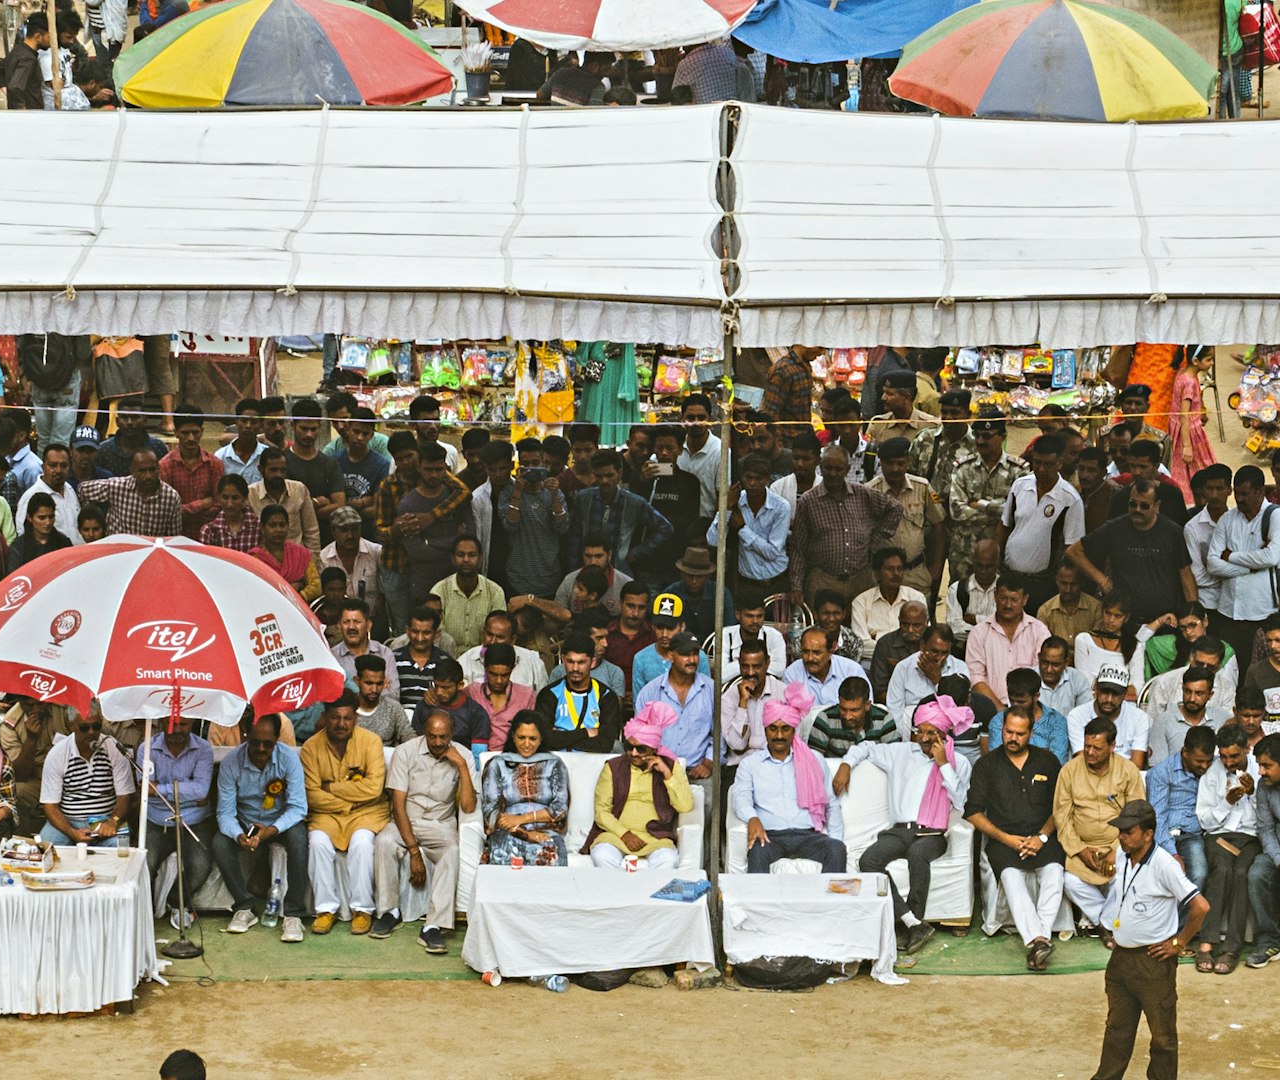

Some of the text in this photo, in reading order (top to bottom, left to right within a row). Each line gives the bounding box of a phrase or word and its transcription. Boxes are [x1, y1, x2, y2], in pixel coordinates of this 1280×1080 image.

[147, 625, 198, 646] itel
[261, 623, 277, 635] OVER
[260, 646, 299, 666] CUSTOMERS
[260, 654, 304, 677] ACROSS INDIA
[31, 674, 56, 692] itel
[136, 667, 213, 681] Smart Phone
[282, 679, 304, 700] itel
